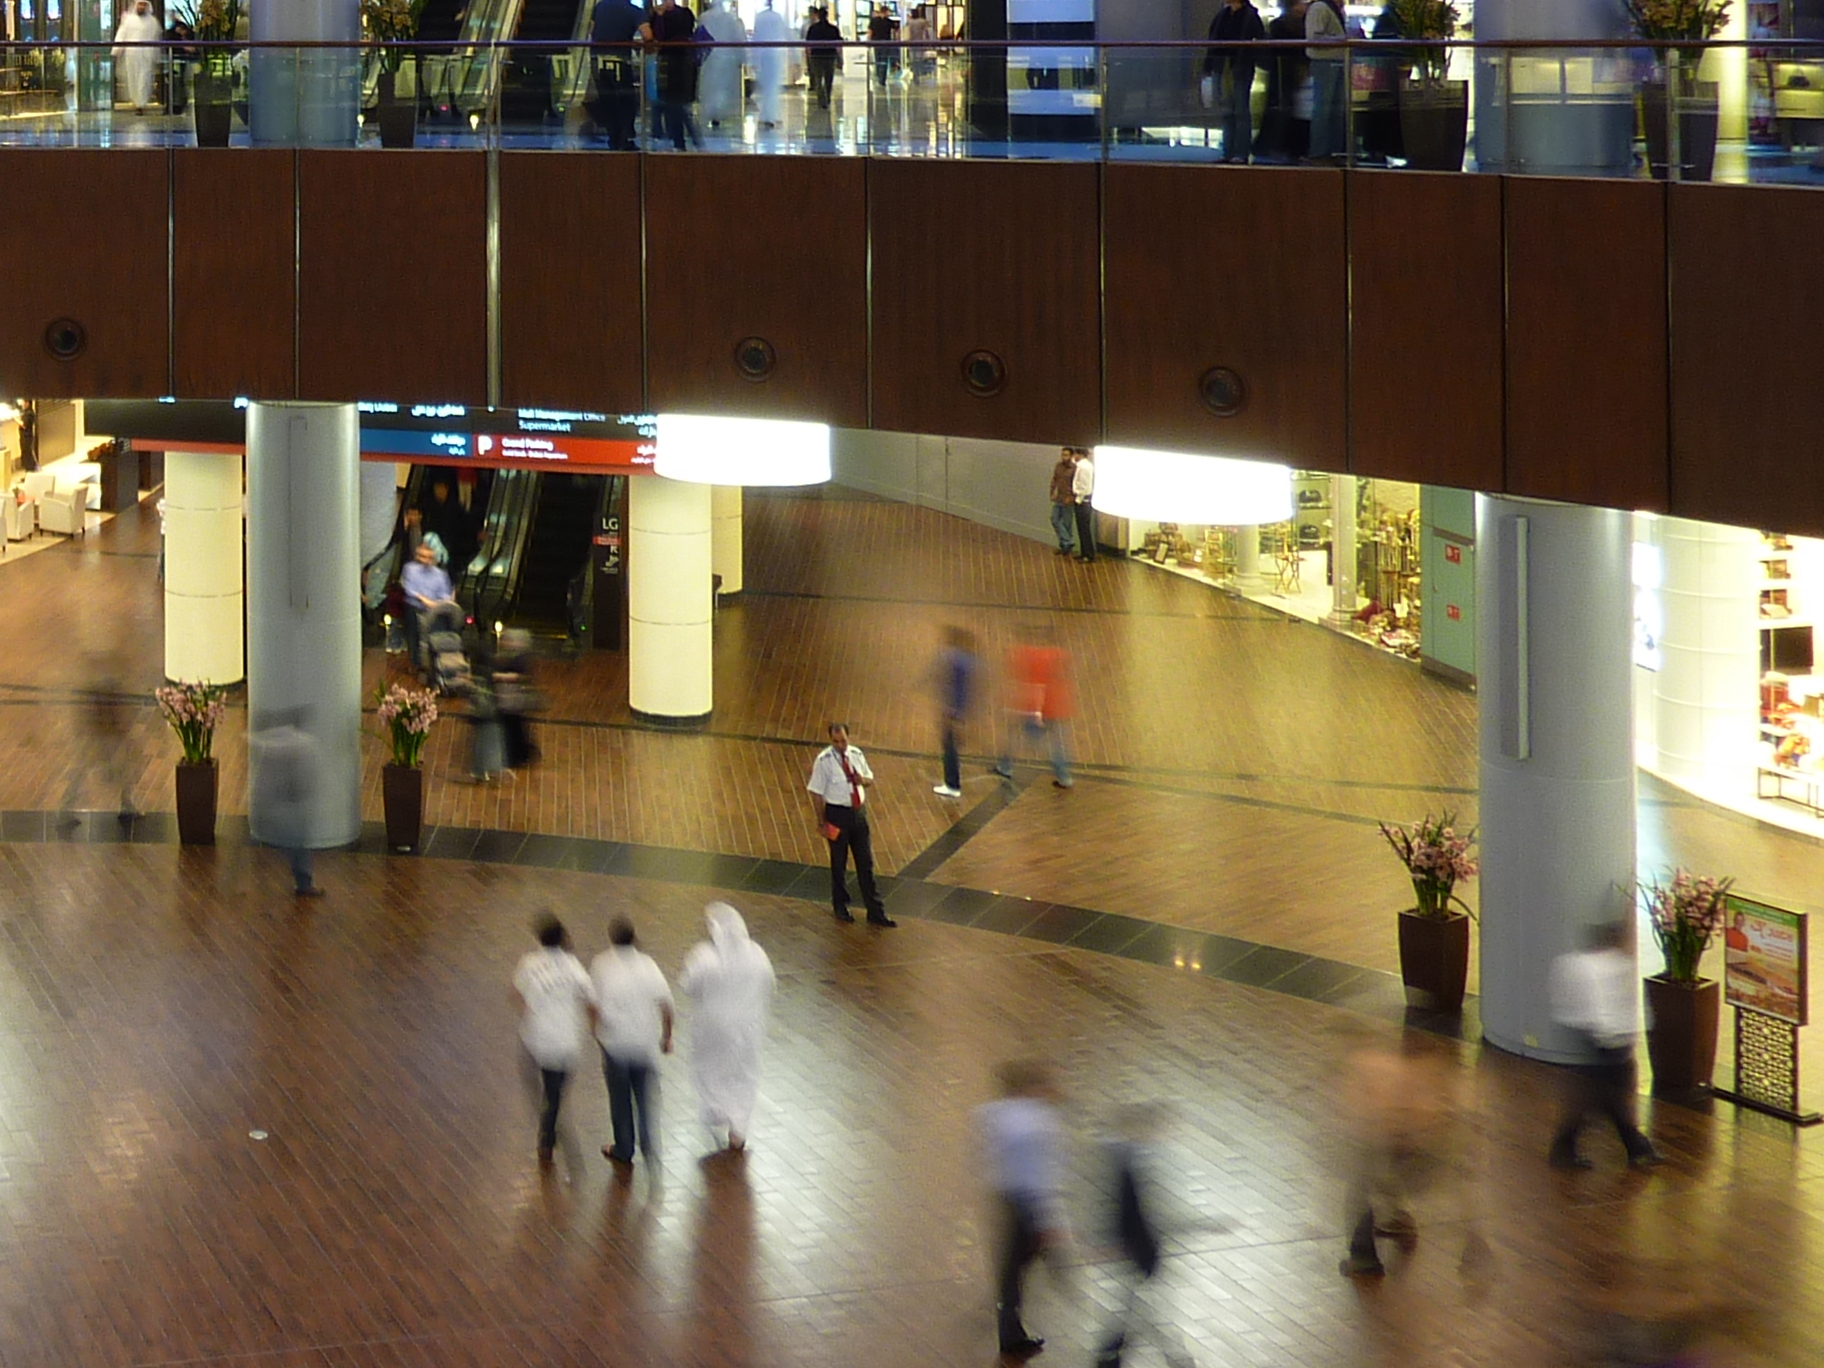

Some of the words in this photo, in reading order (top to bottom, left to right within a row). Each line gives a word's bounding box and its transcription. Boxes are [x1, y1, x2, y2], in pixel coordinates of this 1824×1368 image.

[518, 420, 571, 433] Supermarket
[477, 435, 493, 455] P
[602, 517, 619, 530] LG
